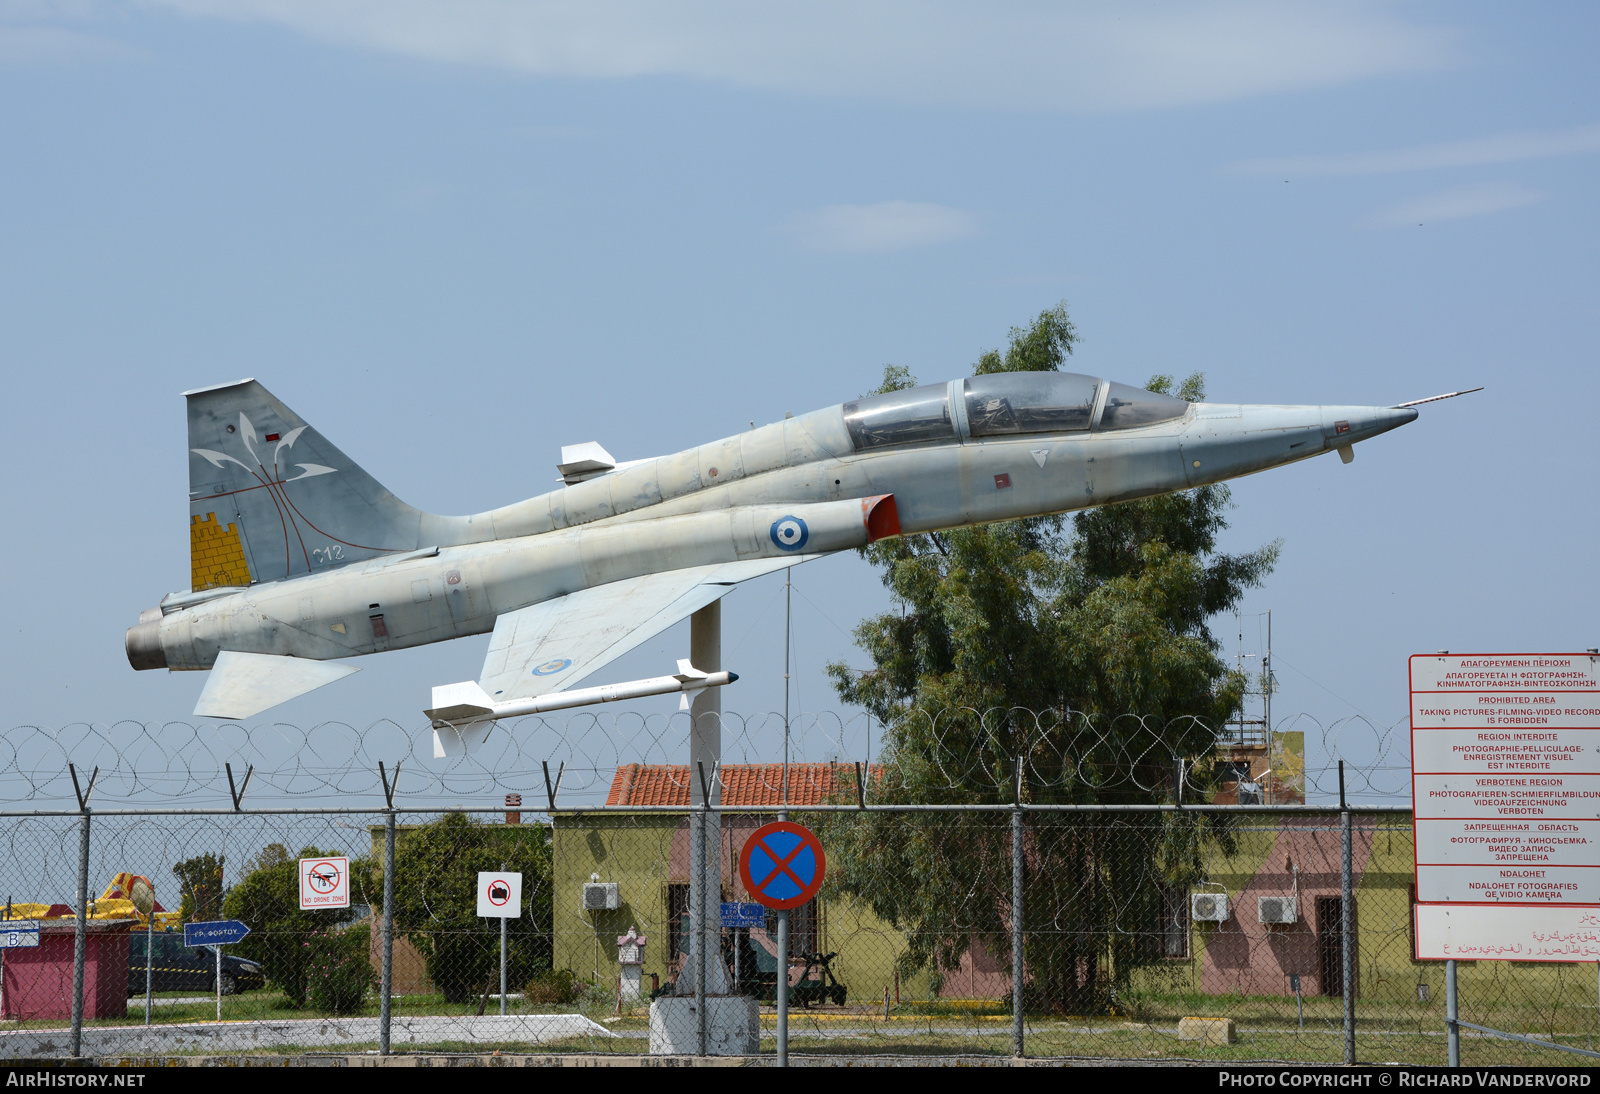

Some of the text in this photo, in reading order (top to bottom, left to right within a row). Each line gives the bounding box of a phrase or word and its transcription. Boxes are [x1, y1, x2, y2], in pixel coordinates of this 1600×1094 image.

[1464, 824, 1530, 832] ЗАПРЕЩЕННАЯ
[332, 895, 345, 903] ZONE
[1525, 891, 1563, 899] KAMERA
